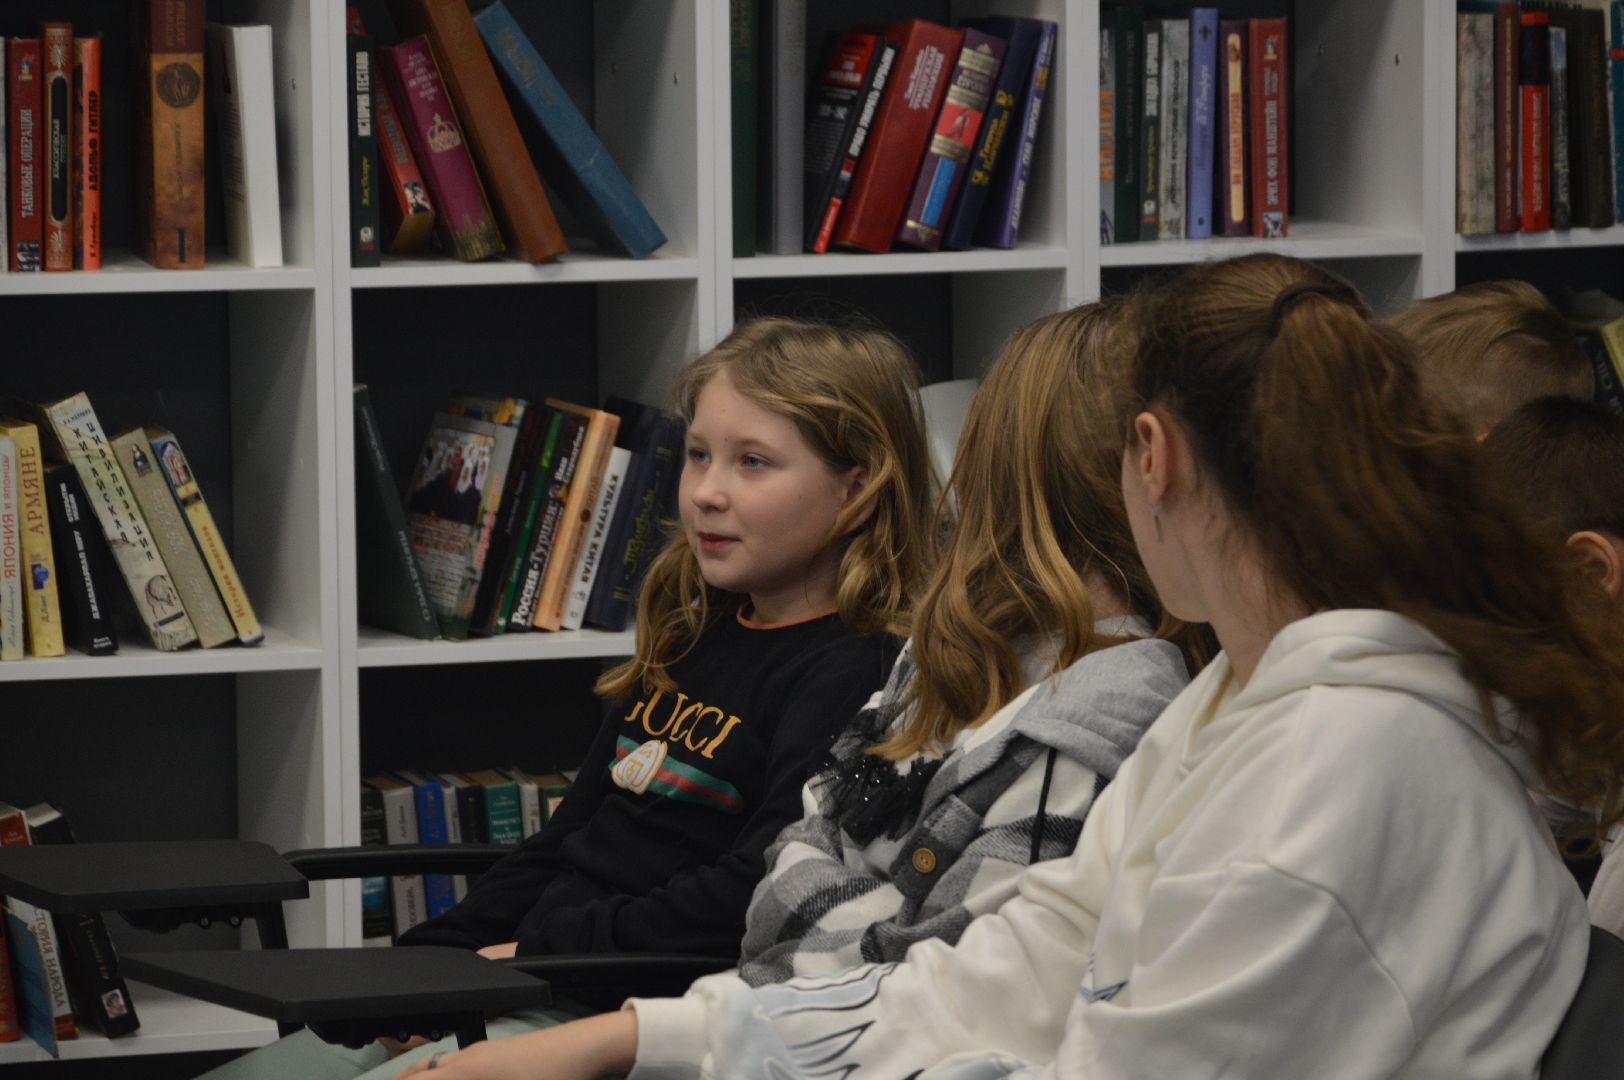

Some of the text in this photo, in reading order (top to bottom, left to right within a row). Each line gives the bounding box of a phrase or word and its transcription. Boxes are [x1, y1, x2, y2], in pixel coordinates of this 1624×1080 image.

[20, 108, 34, 218] ТАНКОВЫЕ ОПЕРАЦИИ
[88, 90, 98, 191] АДОЛЬФ ГИТЛЕР
[20, 447, 43, 535] АРМЯНЕ
[87, 422, 154, 560] ЦИВИЛИЗАЦИЯ
[581, 474, 619, 583] КУЛЬТУРА КИТАЯ
[2, 513, 17, 579] ЯПОНИЯ
